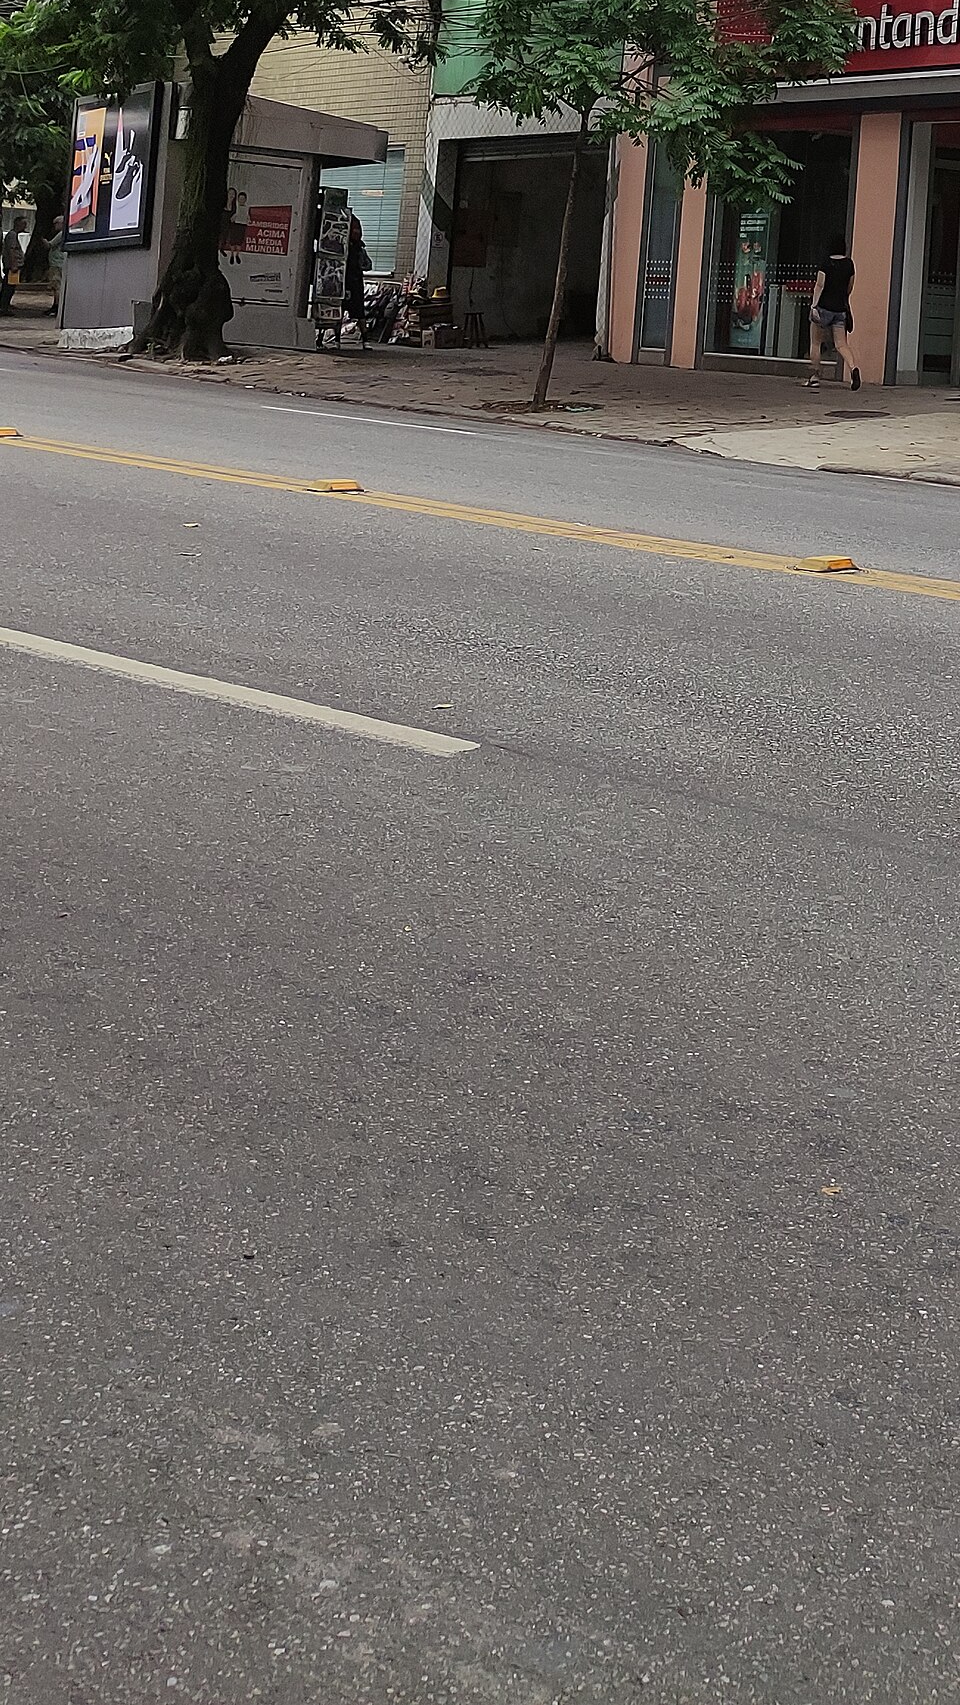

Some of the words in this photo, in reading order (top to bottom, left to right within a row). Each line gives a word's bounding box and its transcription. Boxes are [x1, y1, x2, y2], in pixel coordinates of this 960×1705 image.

[247, 220, 289, 230] CAMBRIDGE
[257, 228, 286, 238] ACIMA
[245, 243, 286, 255] MUNDIAL
